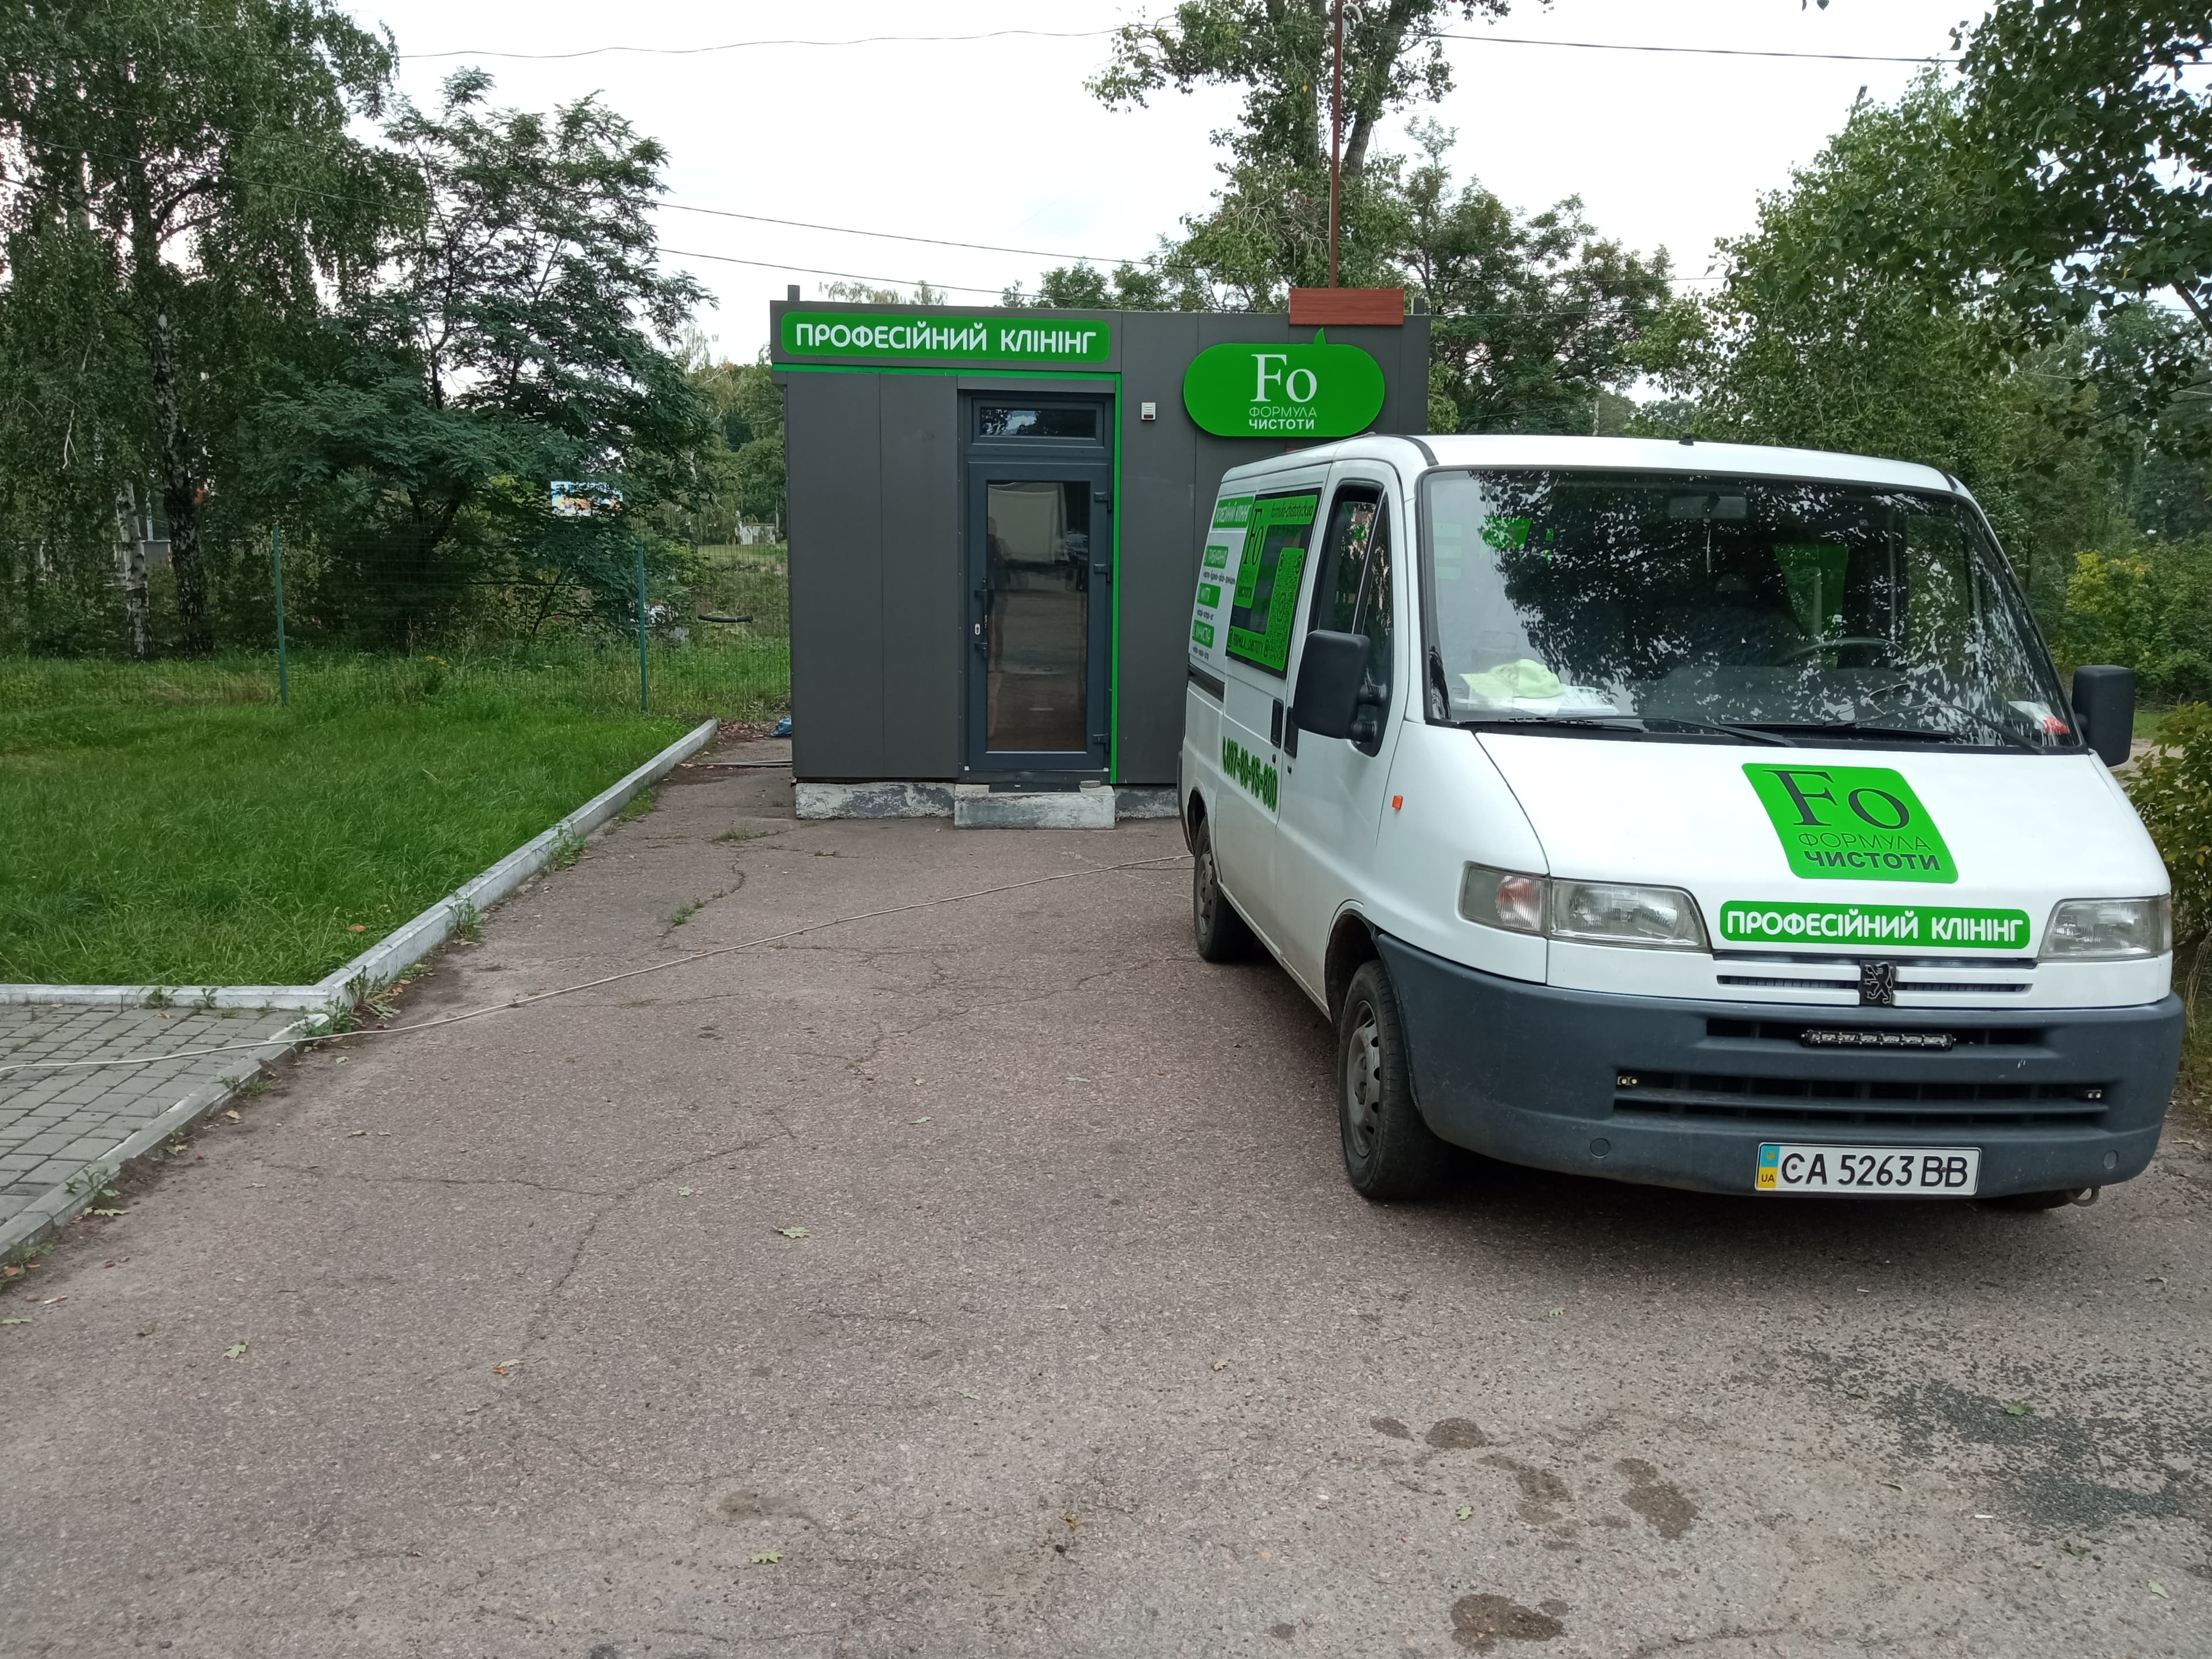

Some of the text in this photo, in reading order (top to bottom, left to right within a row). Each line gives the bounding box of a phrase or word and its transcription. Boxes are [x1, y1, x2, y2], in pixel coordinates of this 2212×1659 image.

[796, 321, 1096, 353] ПРОФЕСІЙНИЙ КЛІНІНГ
[1251, 354, 1317, 403] Fo
[1248, 407, 1317, 418] ФОРМУЛА
[1248, 419, 1315, 430] ЧИСТОТИ
[1243, 508, 1264, 566] Fo
[1762, 770, 1910, 830] Fo
[1798, 832, 1932, 851] ФОРМУЛА
[1804, 851, 1941, 870] ЧИСТОТИ
[1727, 908, 2024, 942] ПРОФЕСІЙНИЙ КЛІНІНГ
[1761, 1174, 1775, 1183] UA
[1781, 1153, 1968, 1188] CA 5263 BB
